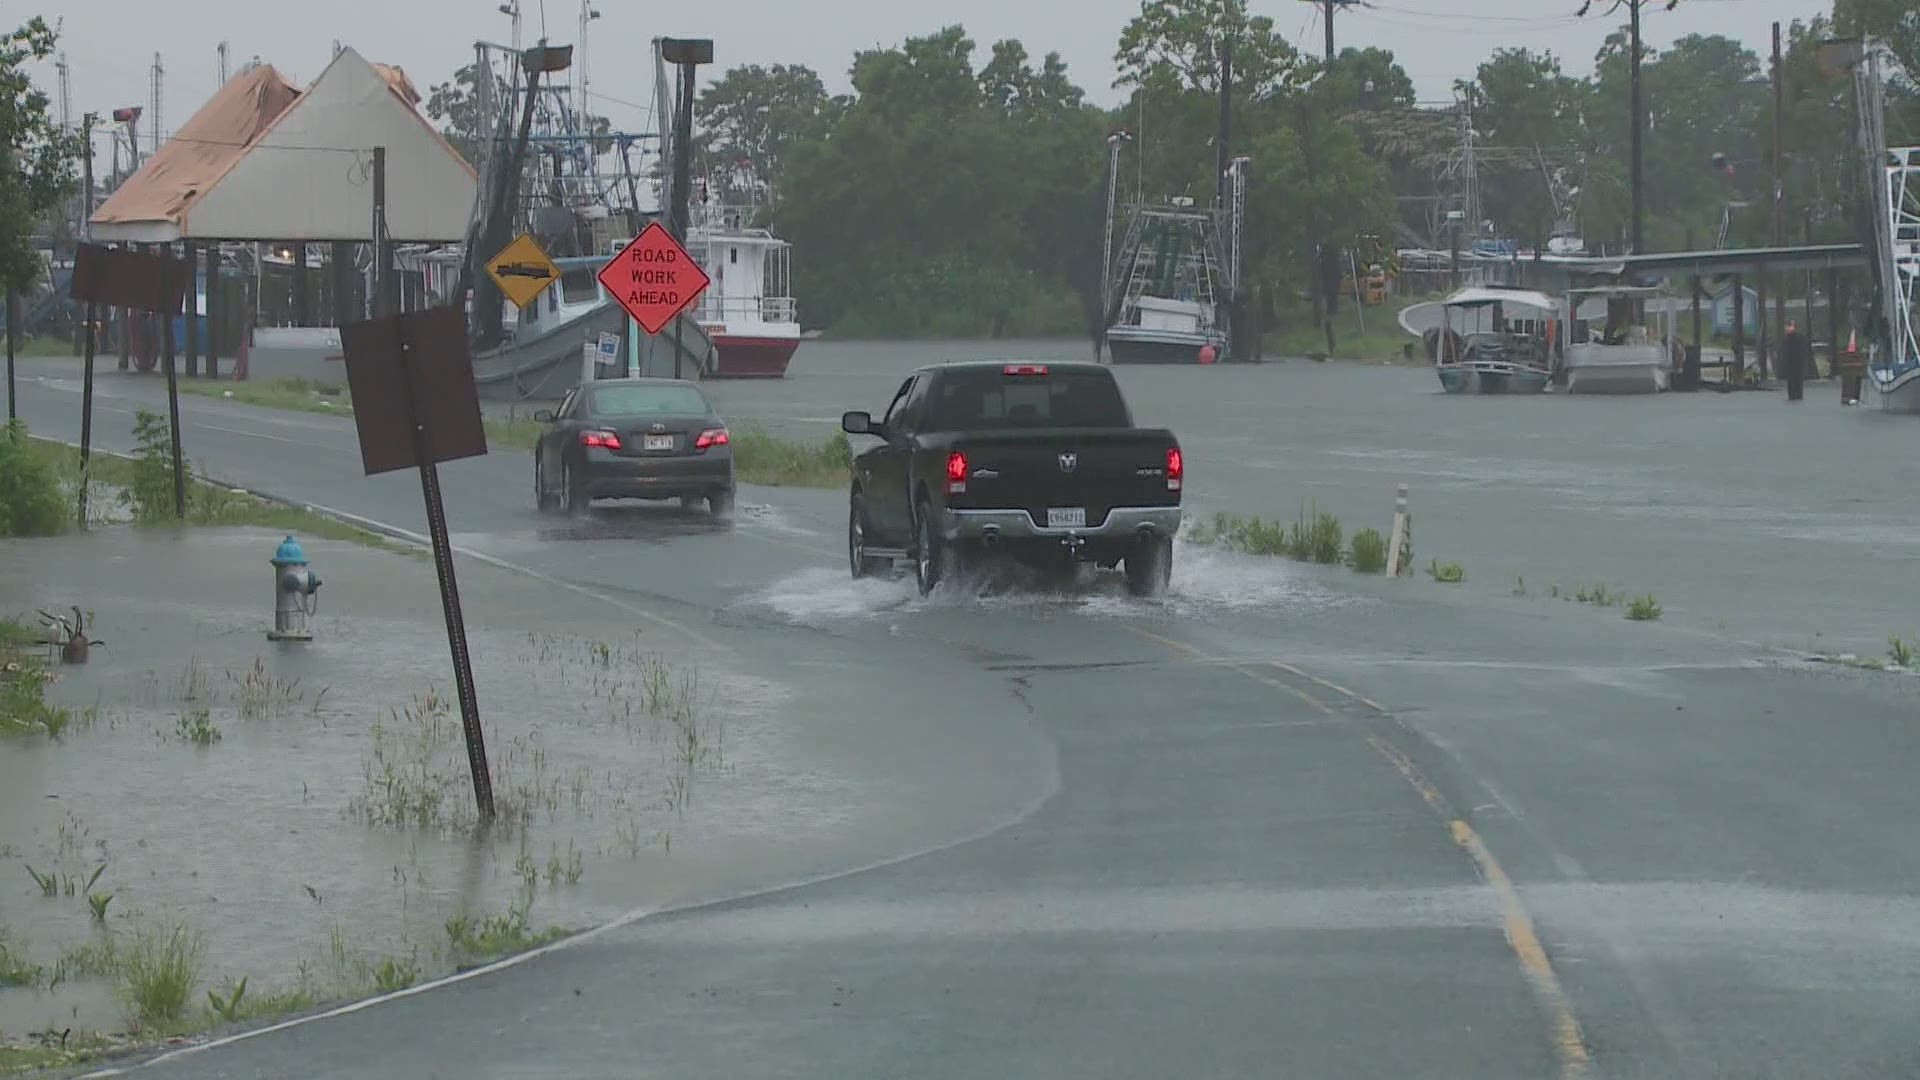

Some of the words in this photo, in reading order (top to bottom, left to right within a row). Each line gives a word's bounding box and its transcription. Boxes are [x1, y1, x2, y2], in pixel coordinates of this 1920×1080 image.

[632, 249, 676, 263] ROAD
[632, 269, 677, 284] WORK
[629, 291, 678, 305] AHEAD
